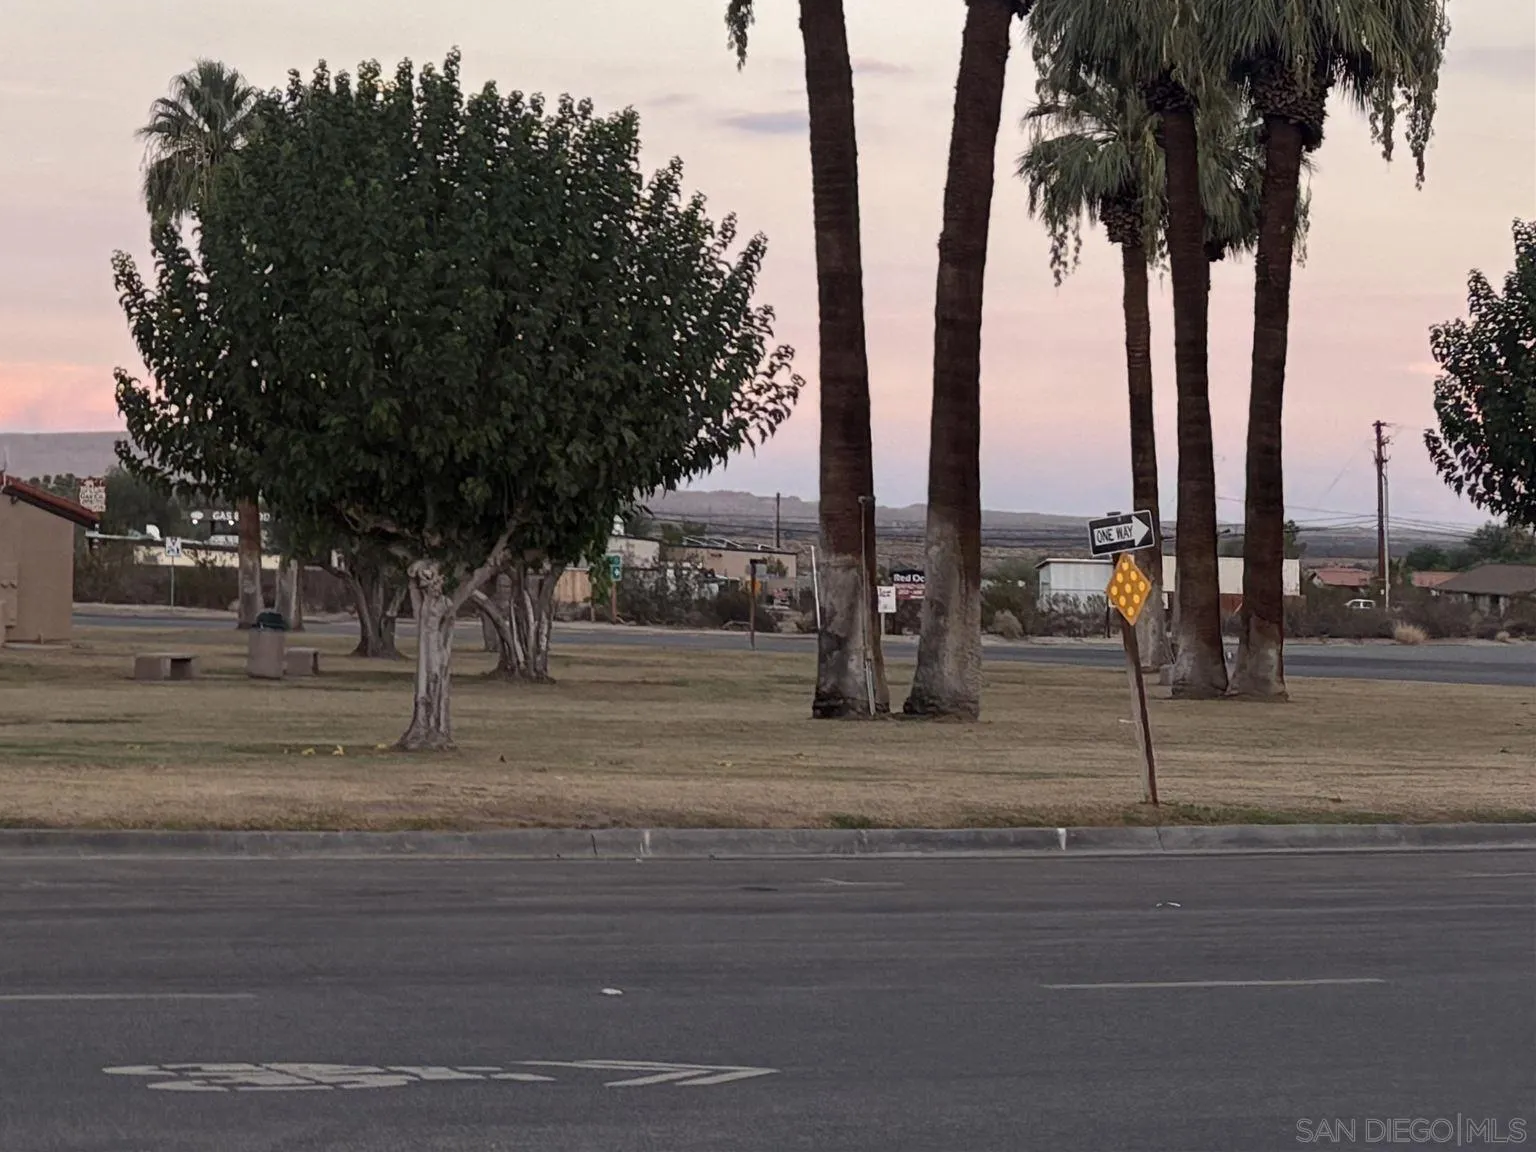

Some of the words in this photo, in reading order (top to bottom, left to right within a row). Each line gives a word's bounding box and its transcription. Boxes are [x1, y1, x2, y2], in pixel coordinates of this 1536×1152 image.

[212, 510, 232, 521] GAS
[1096, 528, 1114, 544] ONE
[1116, 525, 1133, 539] WAY
